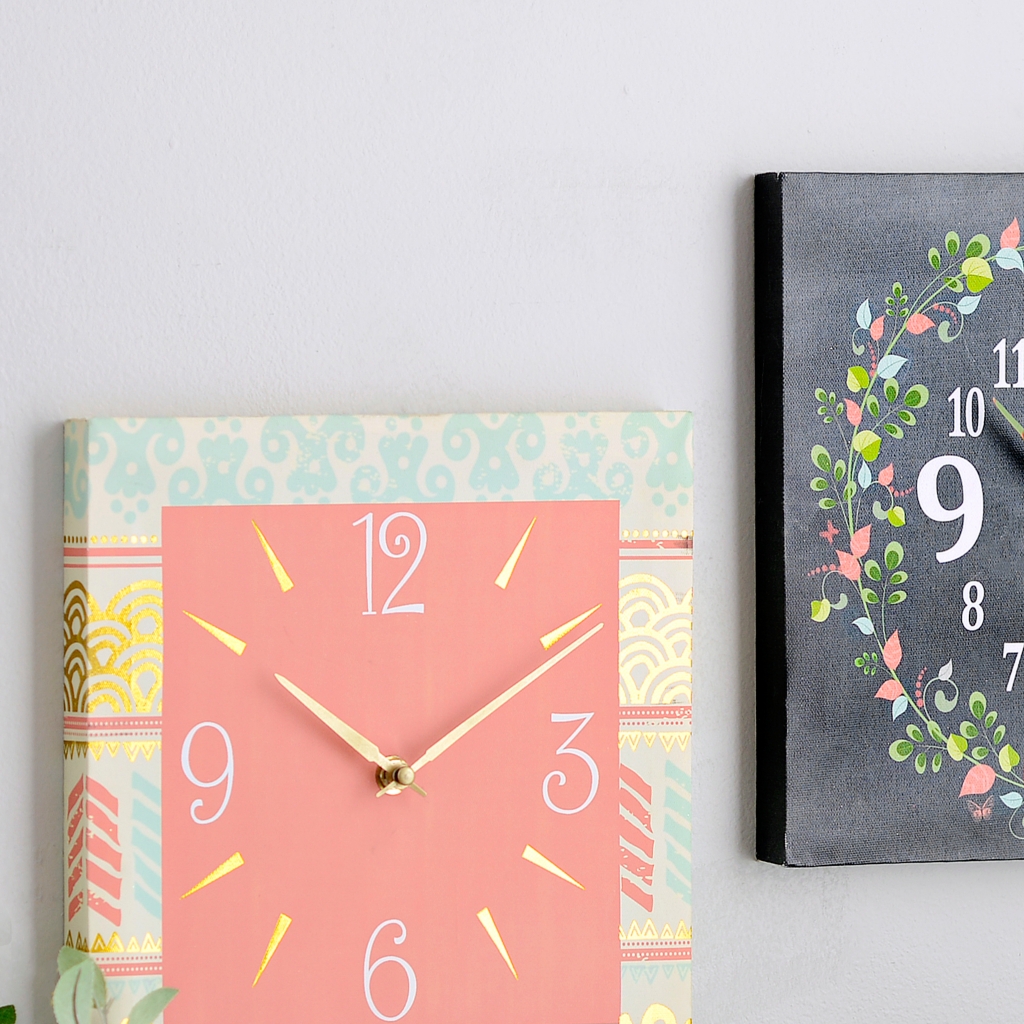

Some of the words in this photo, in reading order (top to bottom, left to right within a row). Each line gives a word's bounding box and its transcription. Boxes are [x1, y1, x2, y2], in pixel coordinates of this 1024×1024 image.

[948, 386, 986, 437] 10
[917, 455, 983, 564] 9
[352, 511, 428, 616] 12
[962, 581, 985, 631] 8
[1003, 643, 1024, 692] 7
[180, 722, 235, 825] 9
[541, 711, 600, 815] 3
[363, 919, 418, 1021] 6
